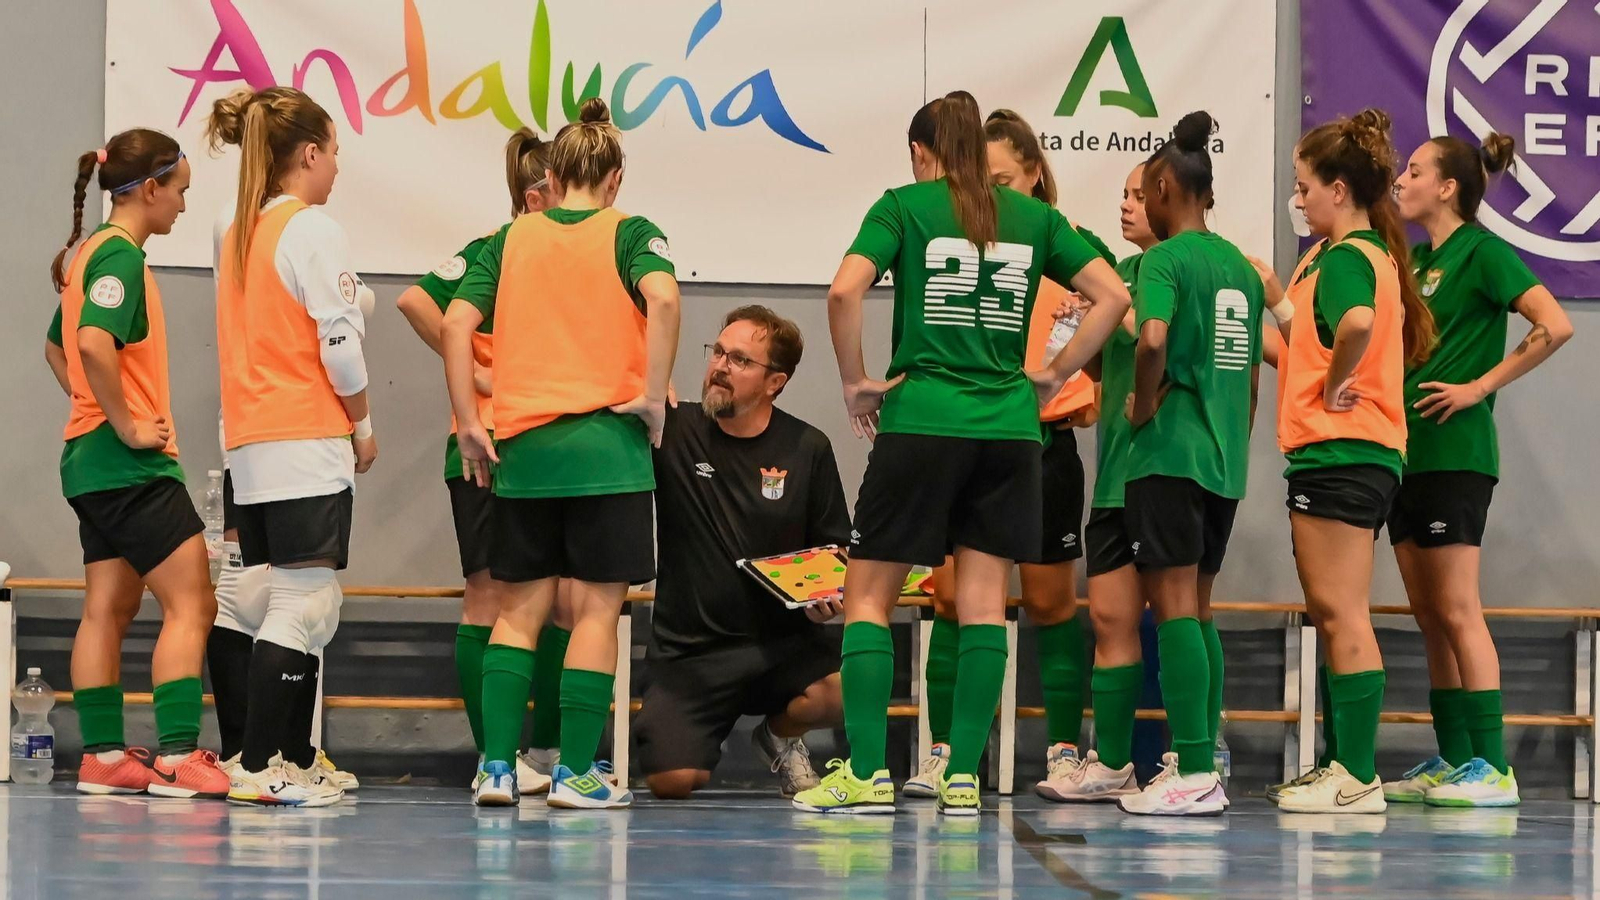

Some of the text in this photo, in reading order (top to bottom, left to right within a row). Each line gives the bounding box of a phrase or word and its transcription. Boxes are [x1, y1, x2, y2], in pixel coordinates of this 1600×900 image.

[168, 0, 833, 154] Andalucía
[1070, 130, 1100, 151] de
[1106, 131, 1225, 154] Andaa
[924, 236, 1034, 332] 23
[1214, 288, 1249, 371] 6
